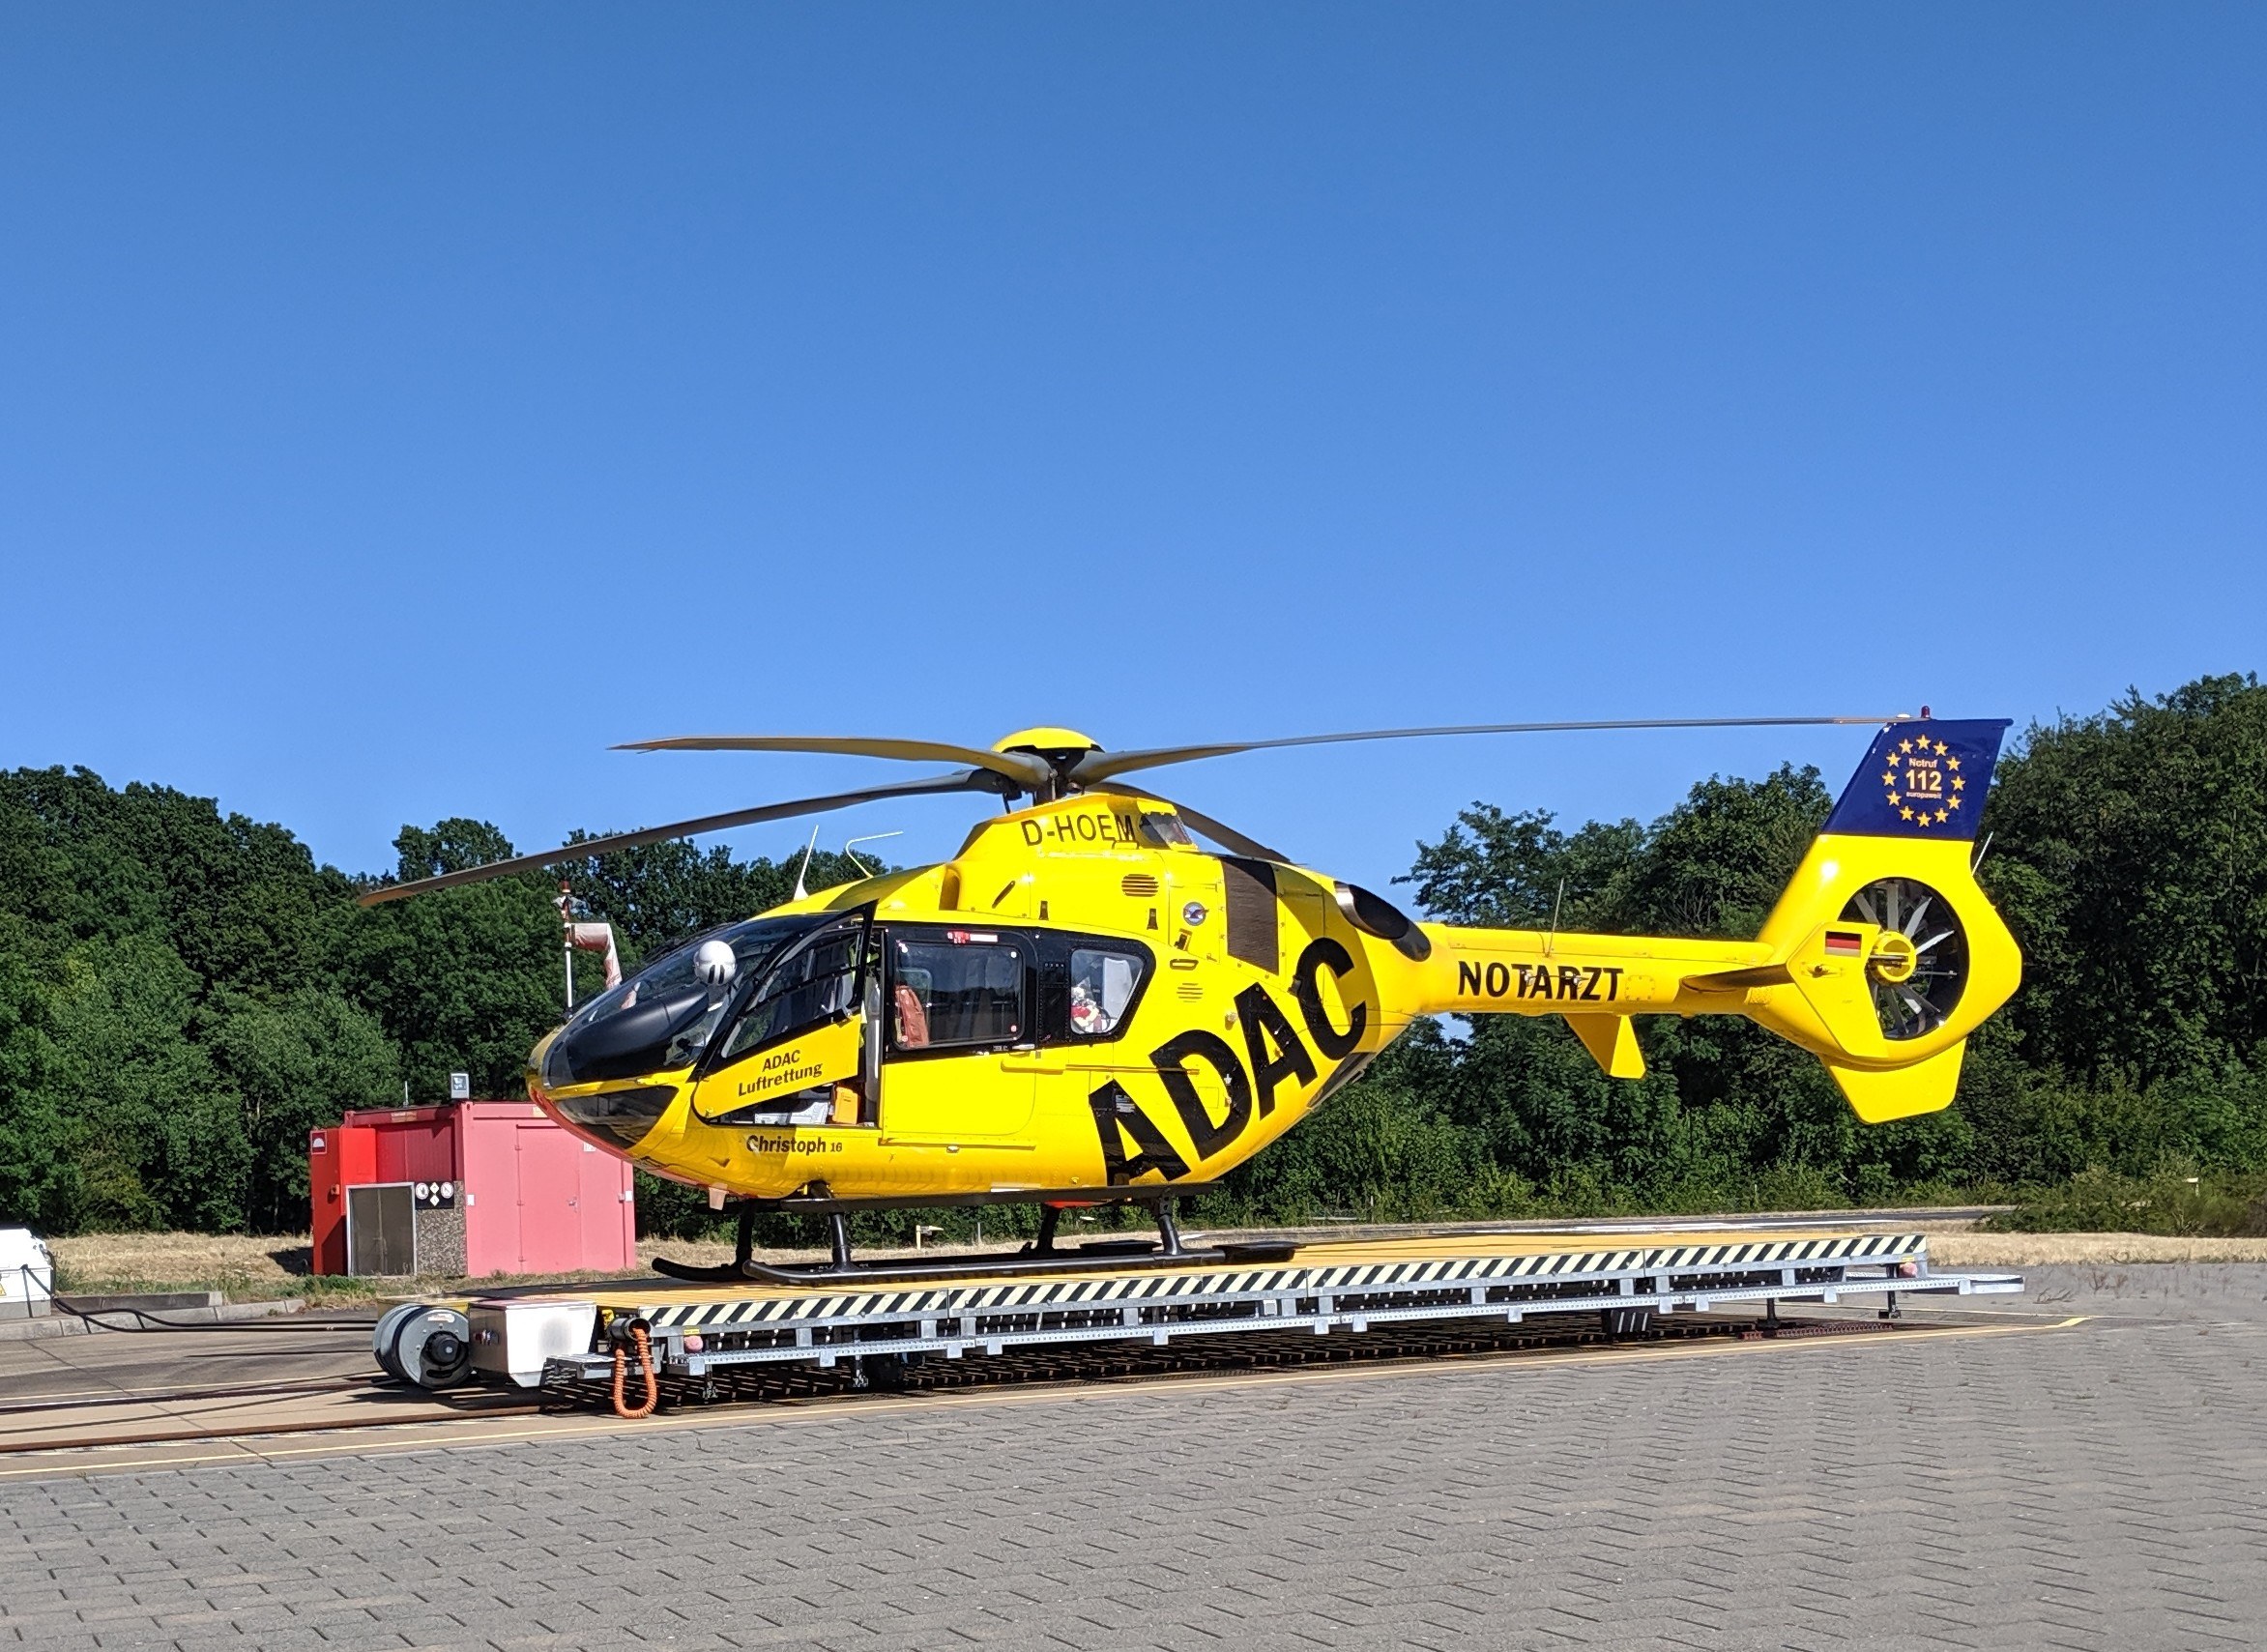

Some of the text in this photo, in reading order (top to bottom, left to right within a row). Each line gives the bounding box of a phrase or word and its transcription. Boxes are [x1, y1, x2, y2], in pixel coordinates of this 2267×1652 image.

[1908, 758, 1938, 768] Notruf
[1905, 768, 1942, 792] 112
[1021, 814, 1136, 847] D-HOEM
[1458, 960, 1624, 1001] NOTARZT
[762, 1050, 800, 1072] ADAC
[1089, 938, 1367, 1187] ADAC
[738, 1063, 823, 1097] Luftrettung
[746, 1134, 843, 1156] Christoph 16
